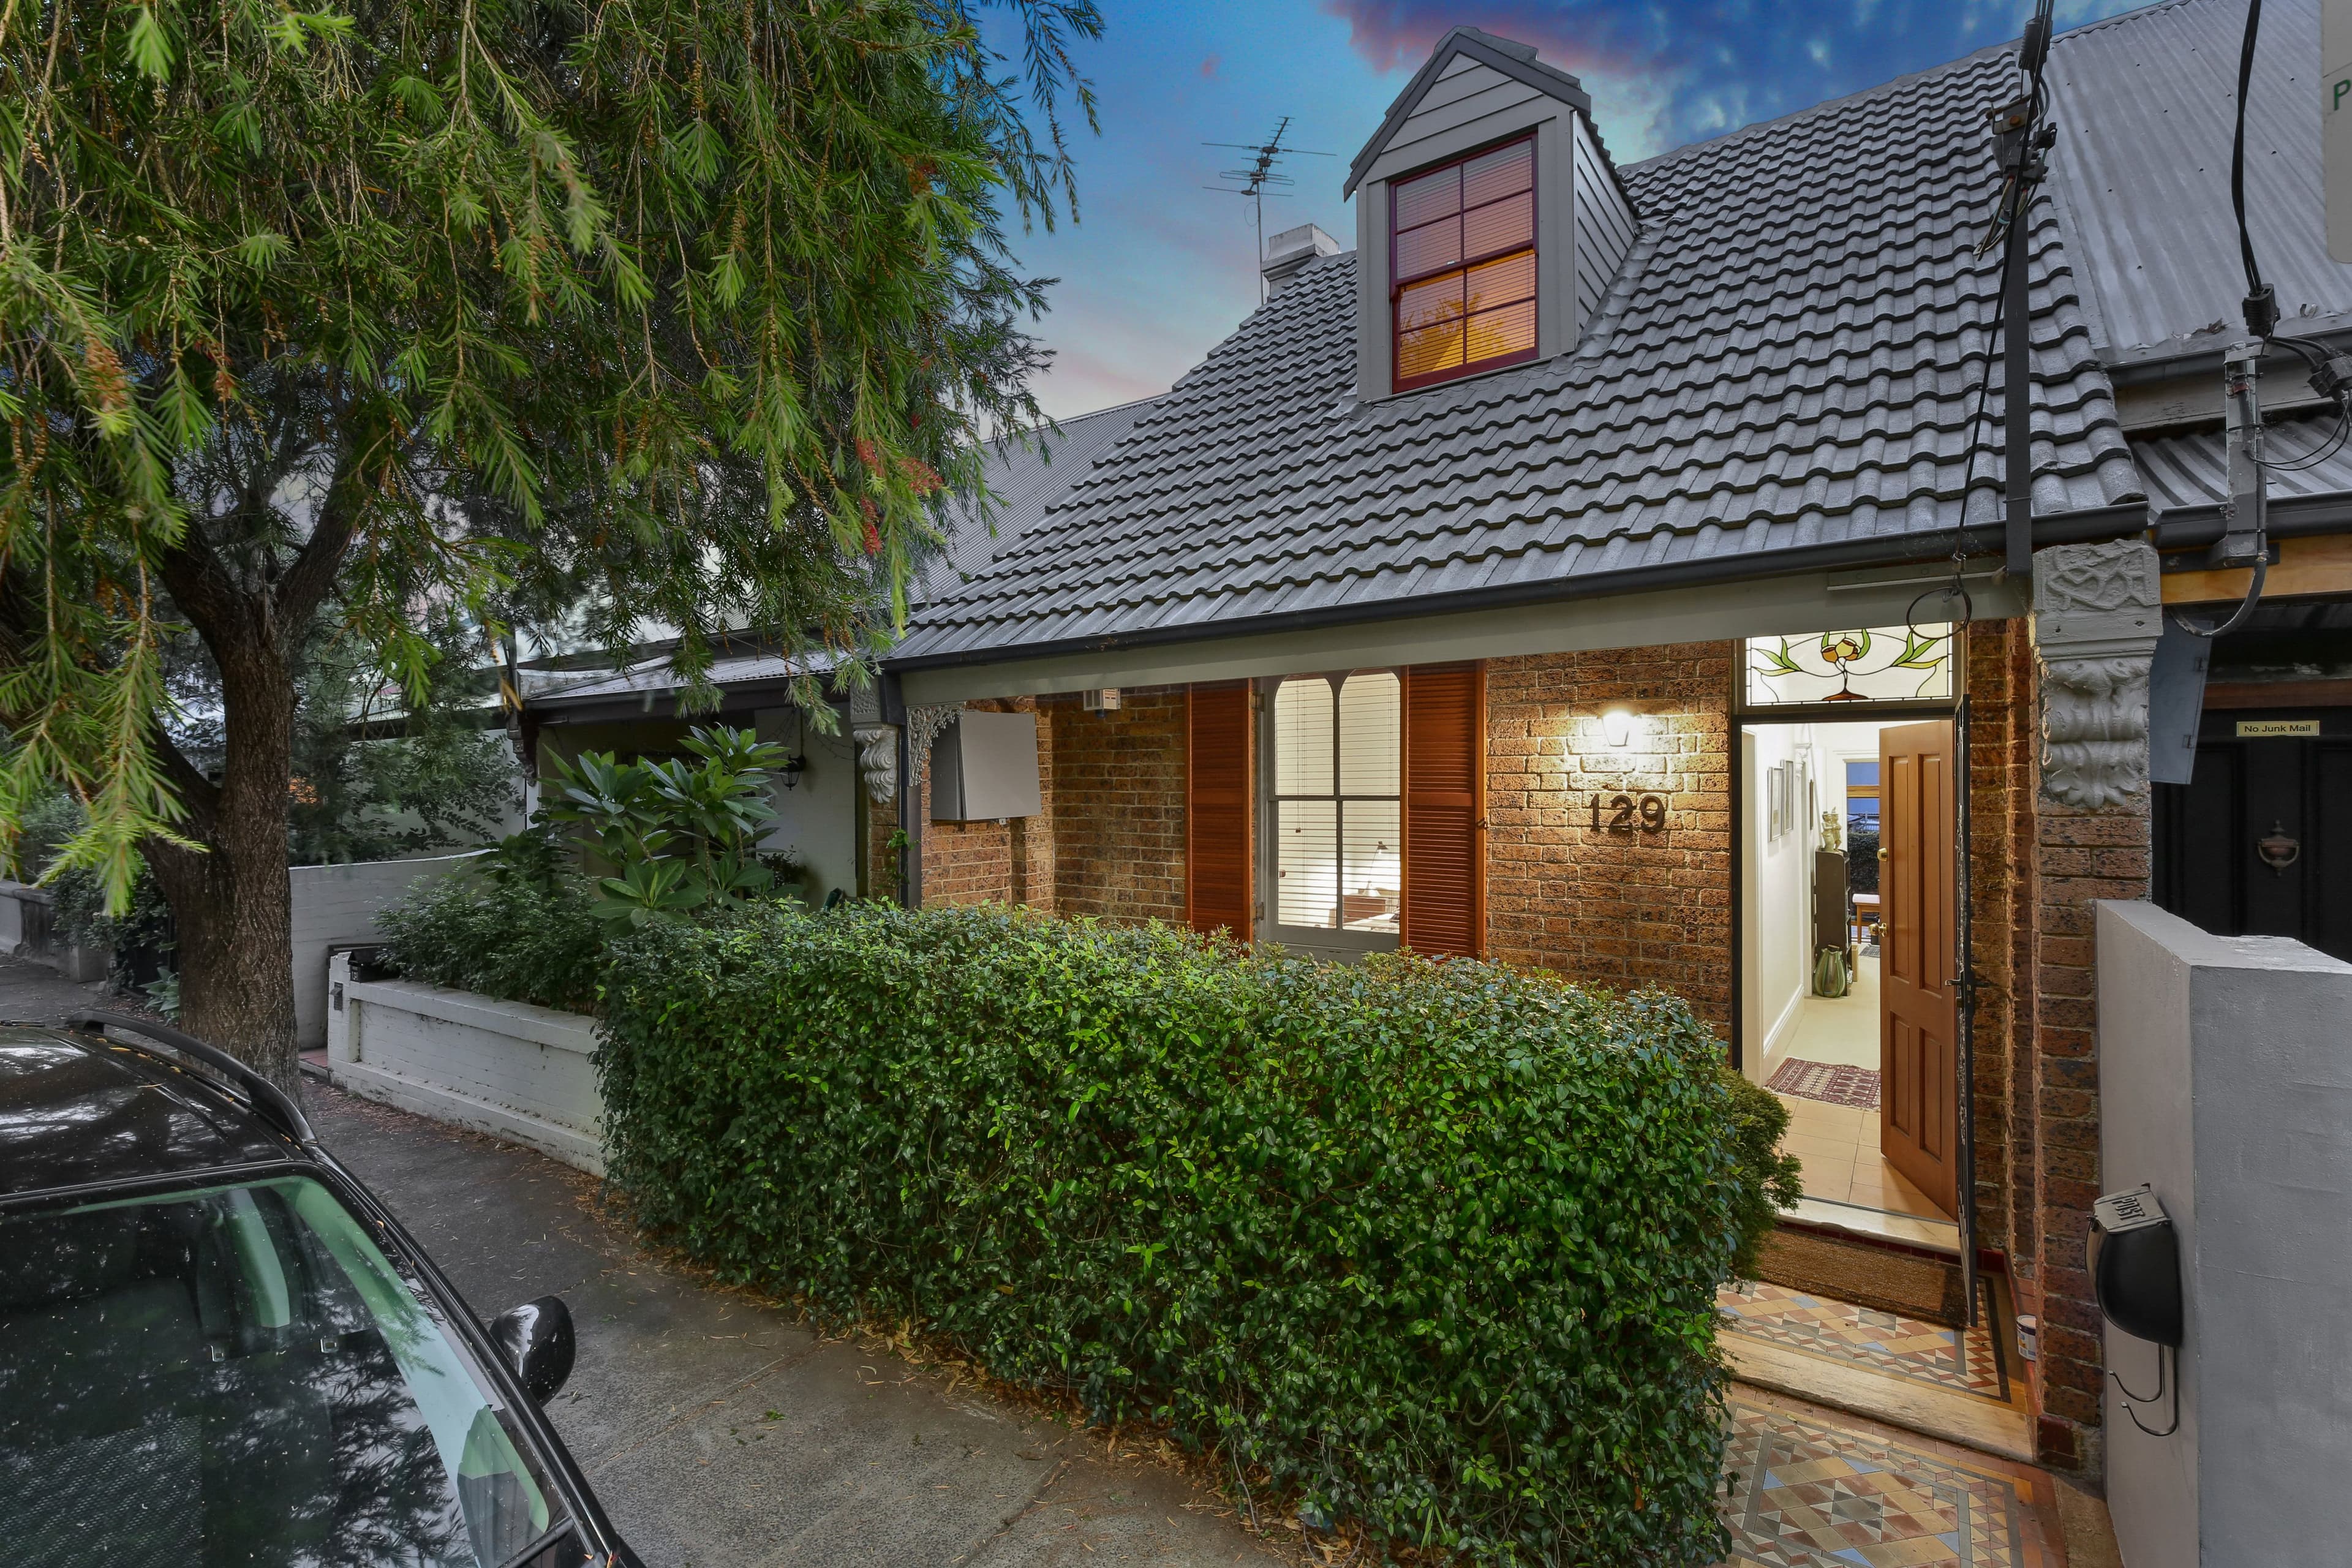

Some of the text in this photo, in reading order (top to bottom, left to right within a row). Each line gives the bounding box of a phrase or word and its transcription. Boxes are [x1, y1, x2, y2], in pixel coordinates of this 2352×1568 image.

[2334, 80, 2351, 111] P
[1590, 793, 1664, 834] 129
[2111, 1197, 2146, 1221] POST
